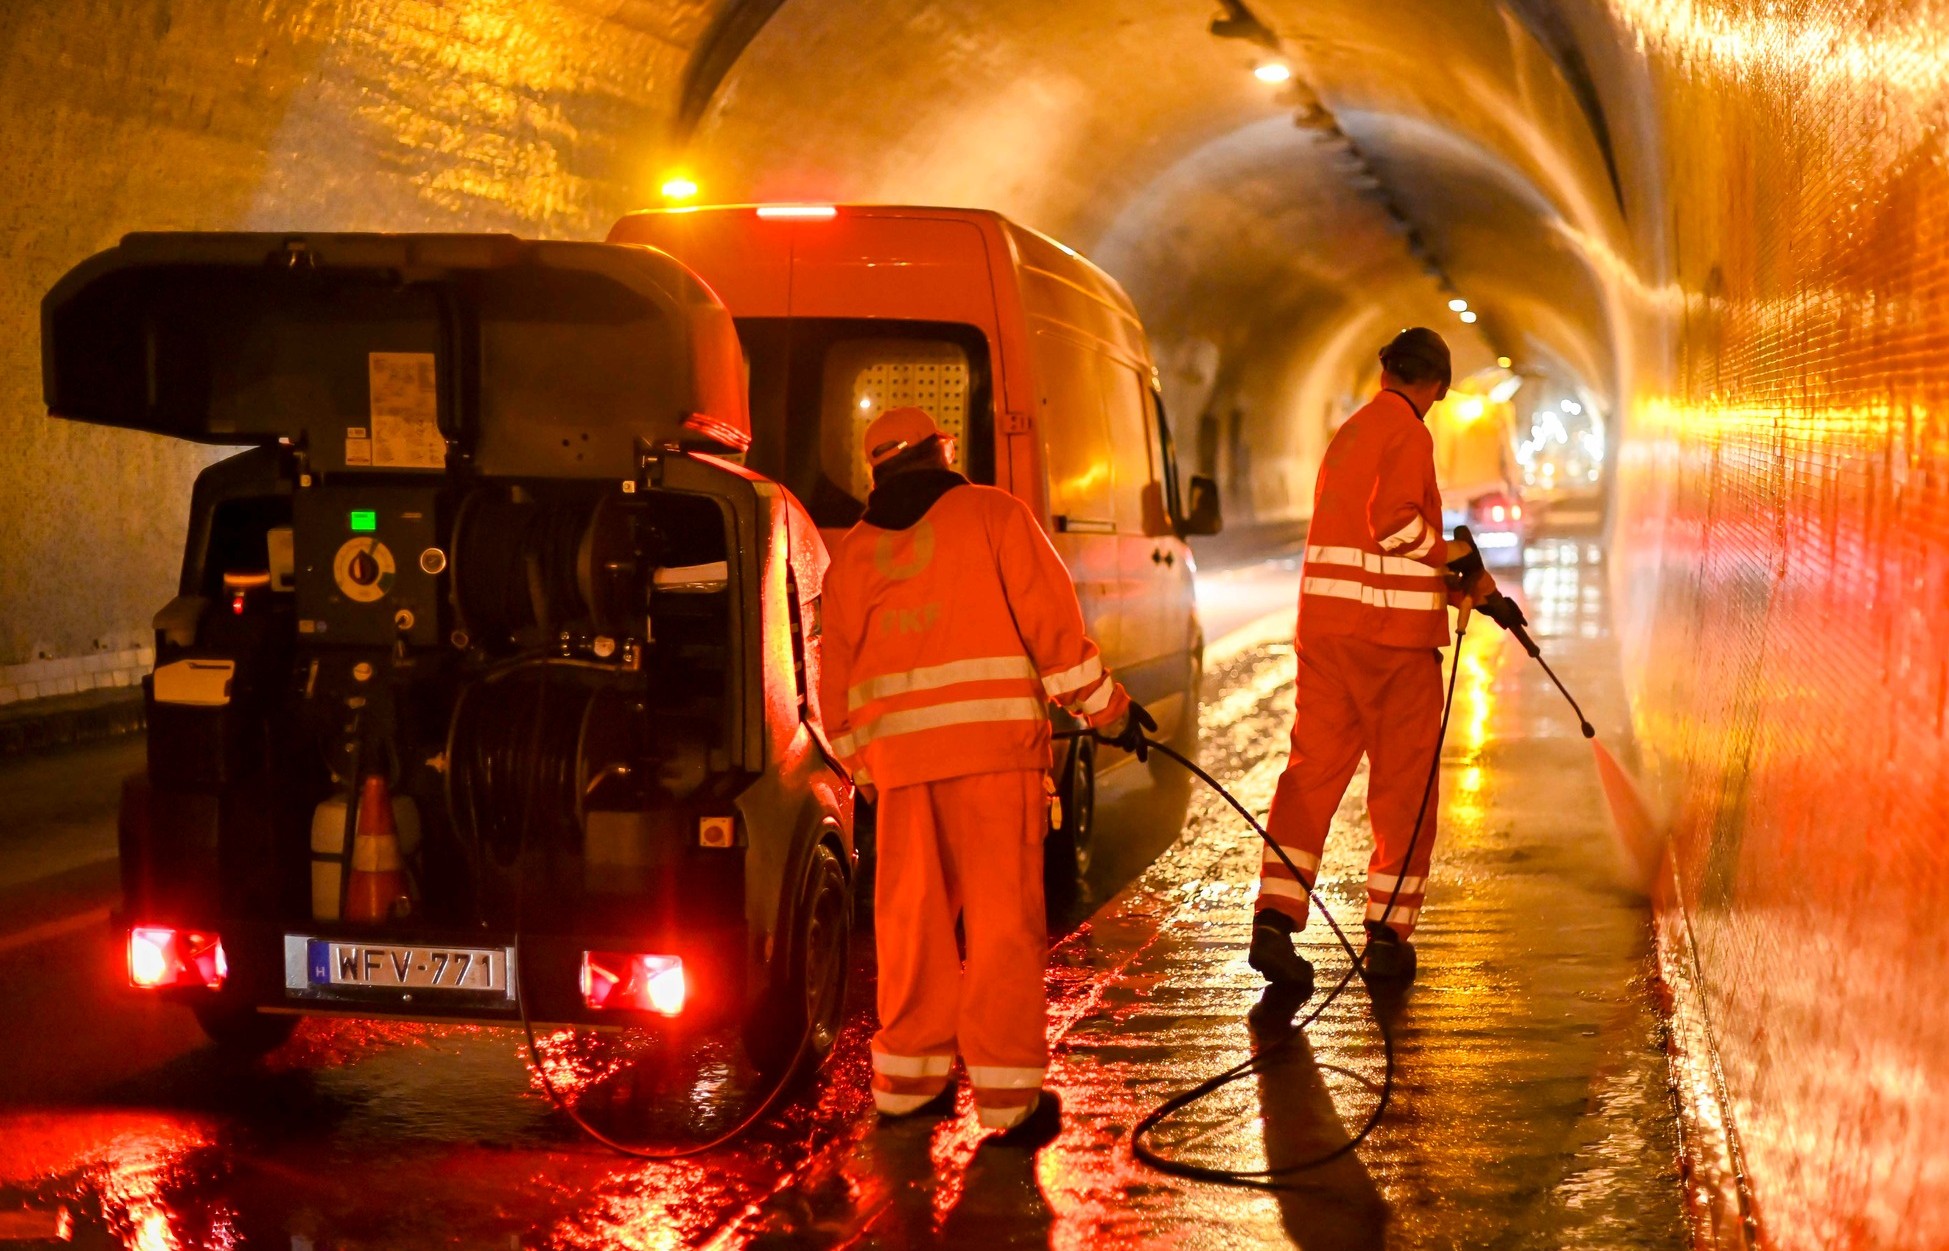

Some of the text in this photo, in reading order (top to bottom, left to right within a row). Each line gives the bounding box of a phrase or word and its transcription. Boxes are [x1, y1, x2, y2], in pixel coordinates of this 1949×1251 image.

[881, 603, 940, 636] FKF
[315, 947, 493, 987] H WFV-771
